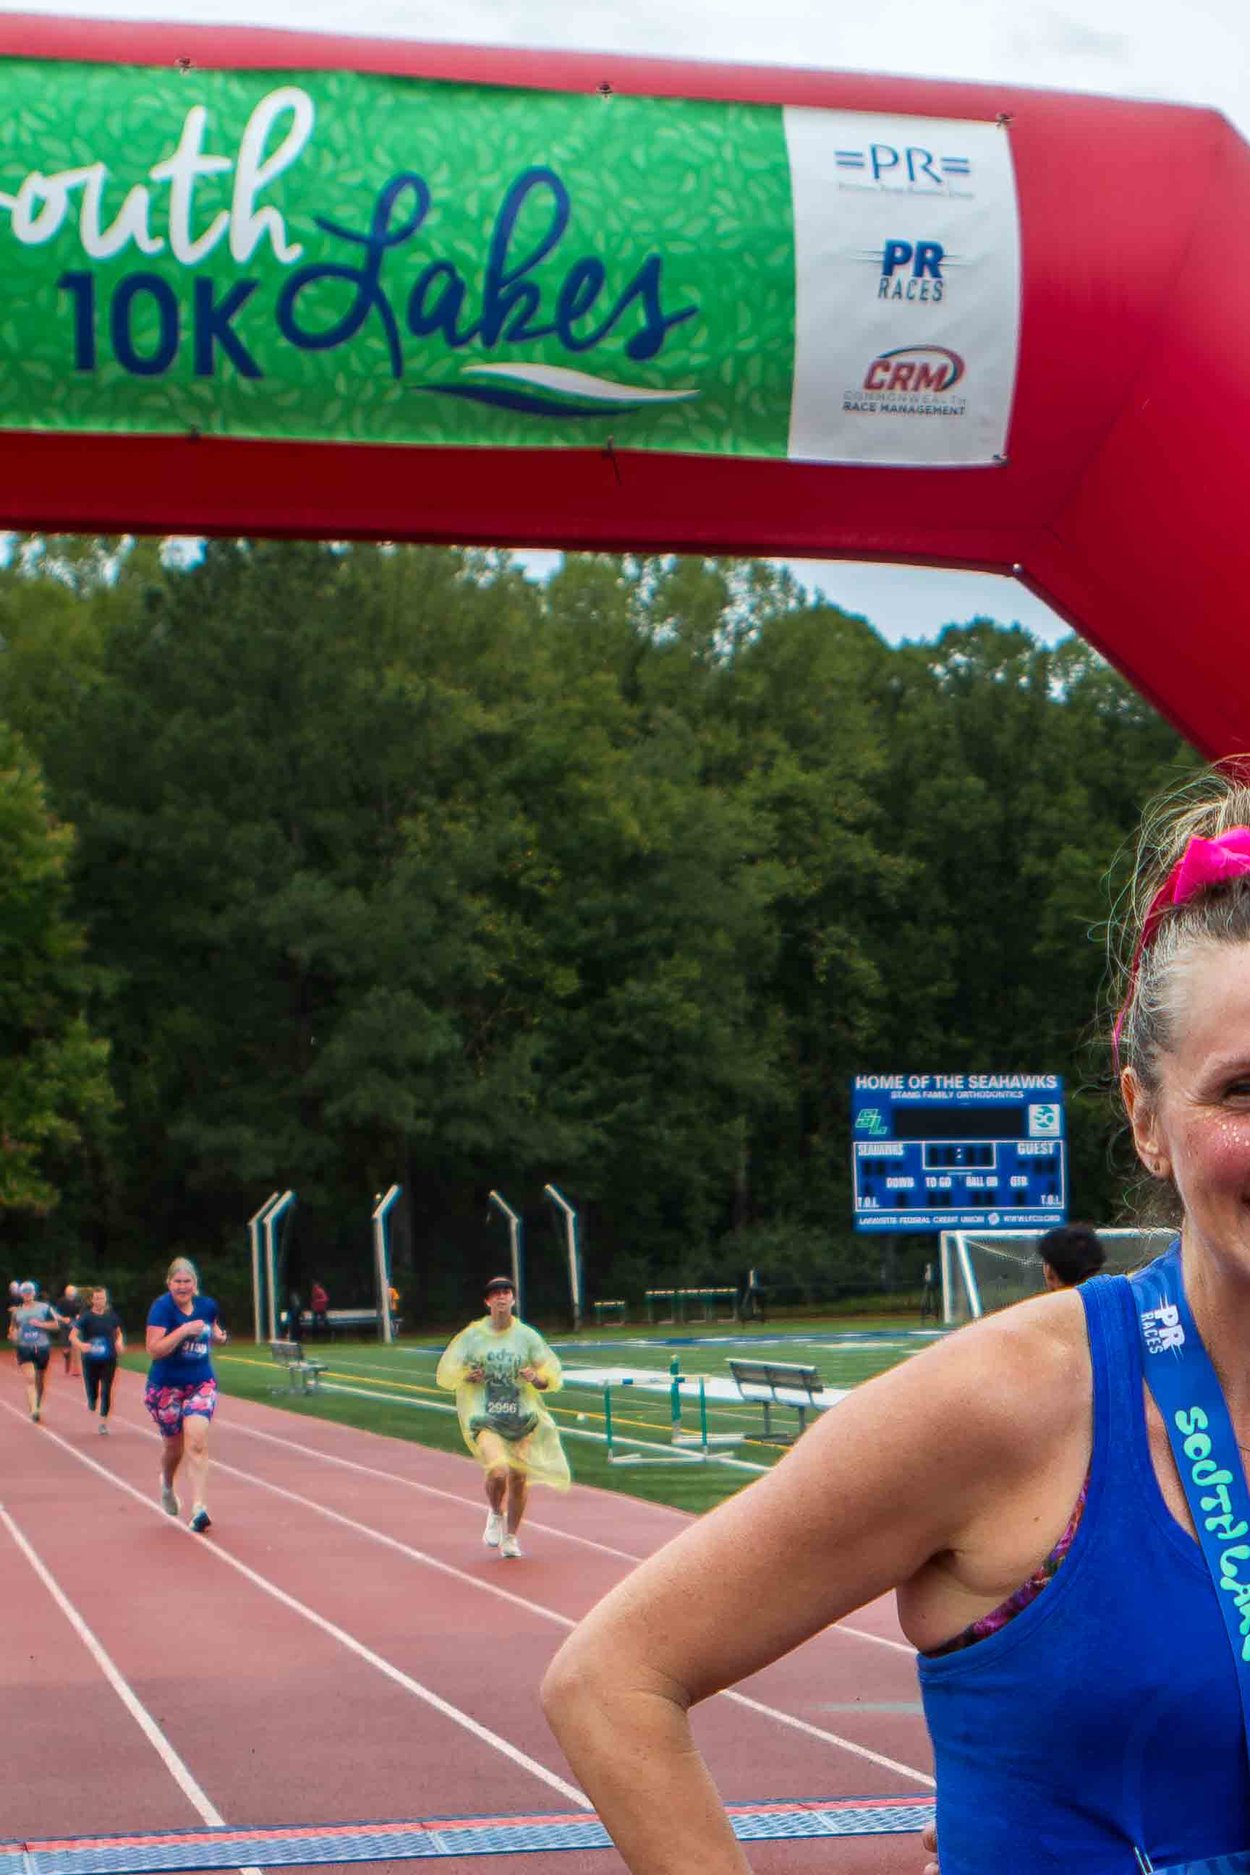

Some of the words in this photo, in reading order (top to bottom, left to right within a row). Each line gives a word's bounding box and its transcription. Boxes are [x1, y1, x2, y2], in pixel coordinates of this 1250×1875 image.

[0, 86, 315, 264] outh
[275, 165, 700, 380] Lakes
[881, 239, 946, 278] PR
[877, 277, 944, 302] RACES
[57, 271, 264, 380] 10K
[863, 360, 949, 392] CRM
[842, 401, 878, 413] RACE
[880, 404, 967, 416] MANAGEMENT
[855, 1075, 904, 1089] HOME
[908, 1075, 931, 1089] OF
[933, 1075, 965, 1089] THE
[968, 1075, 1058, 1089] SEAHAWKS
[1017, 1143, 1054, 1154] GUEST
[925, 1177, 936, 1188] TO
[1141, 1312, 1164, 1354] RACES
[1154, 1304, 1185, 1351] PR
[1174, 1406, 1249, 1540] SOUTH
